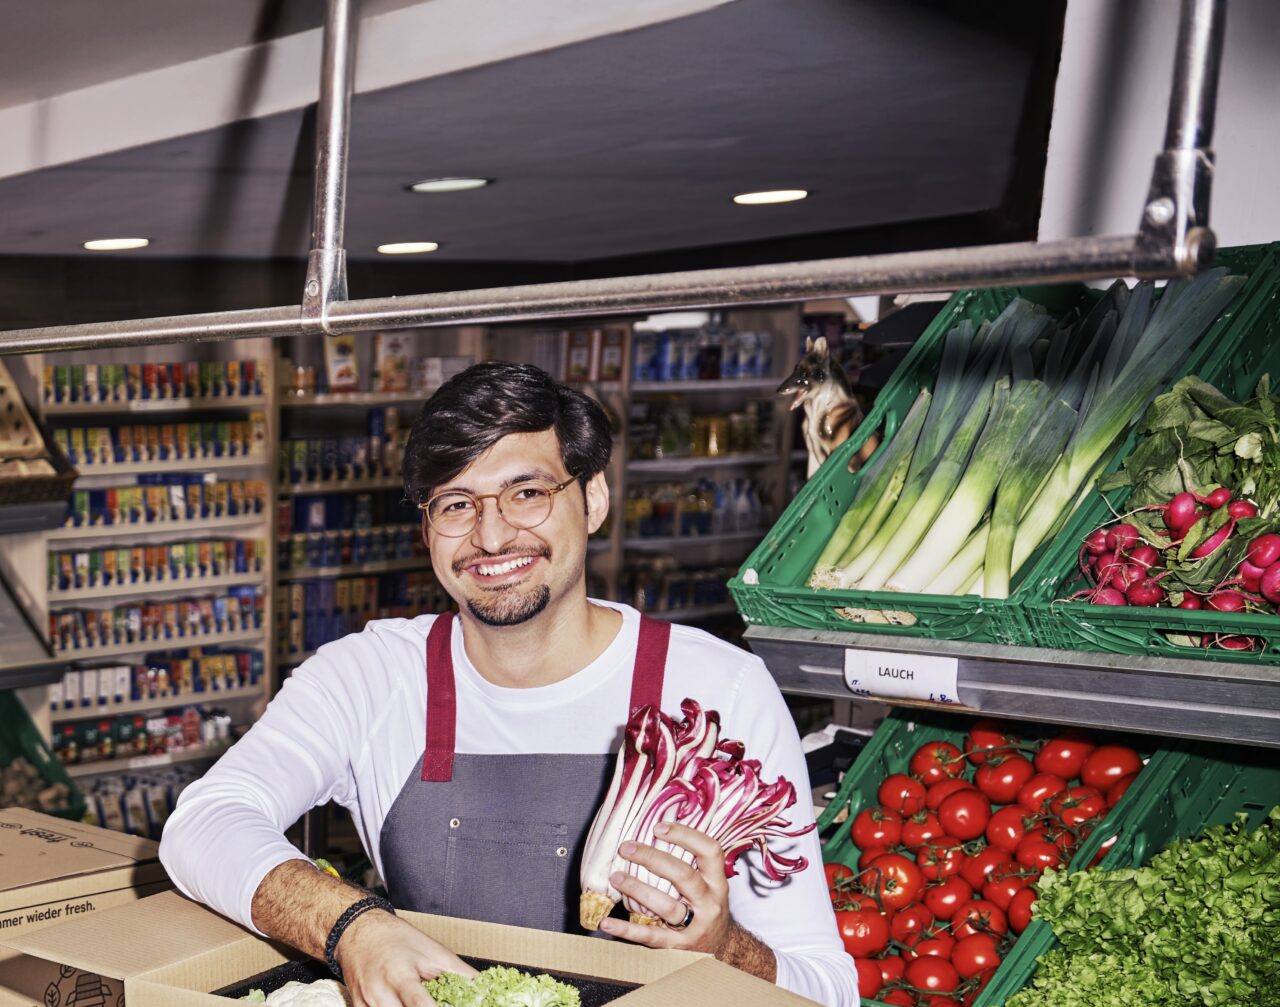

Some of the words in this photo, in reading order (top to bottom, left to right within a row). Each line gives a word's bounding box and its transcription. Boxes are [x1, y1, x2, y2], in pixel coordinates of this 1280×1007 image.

[878, 667, 914, 680] LAUCH
[26, 908, 62, 923] wieder
[65, 900, 96, 915] fresh.
